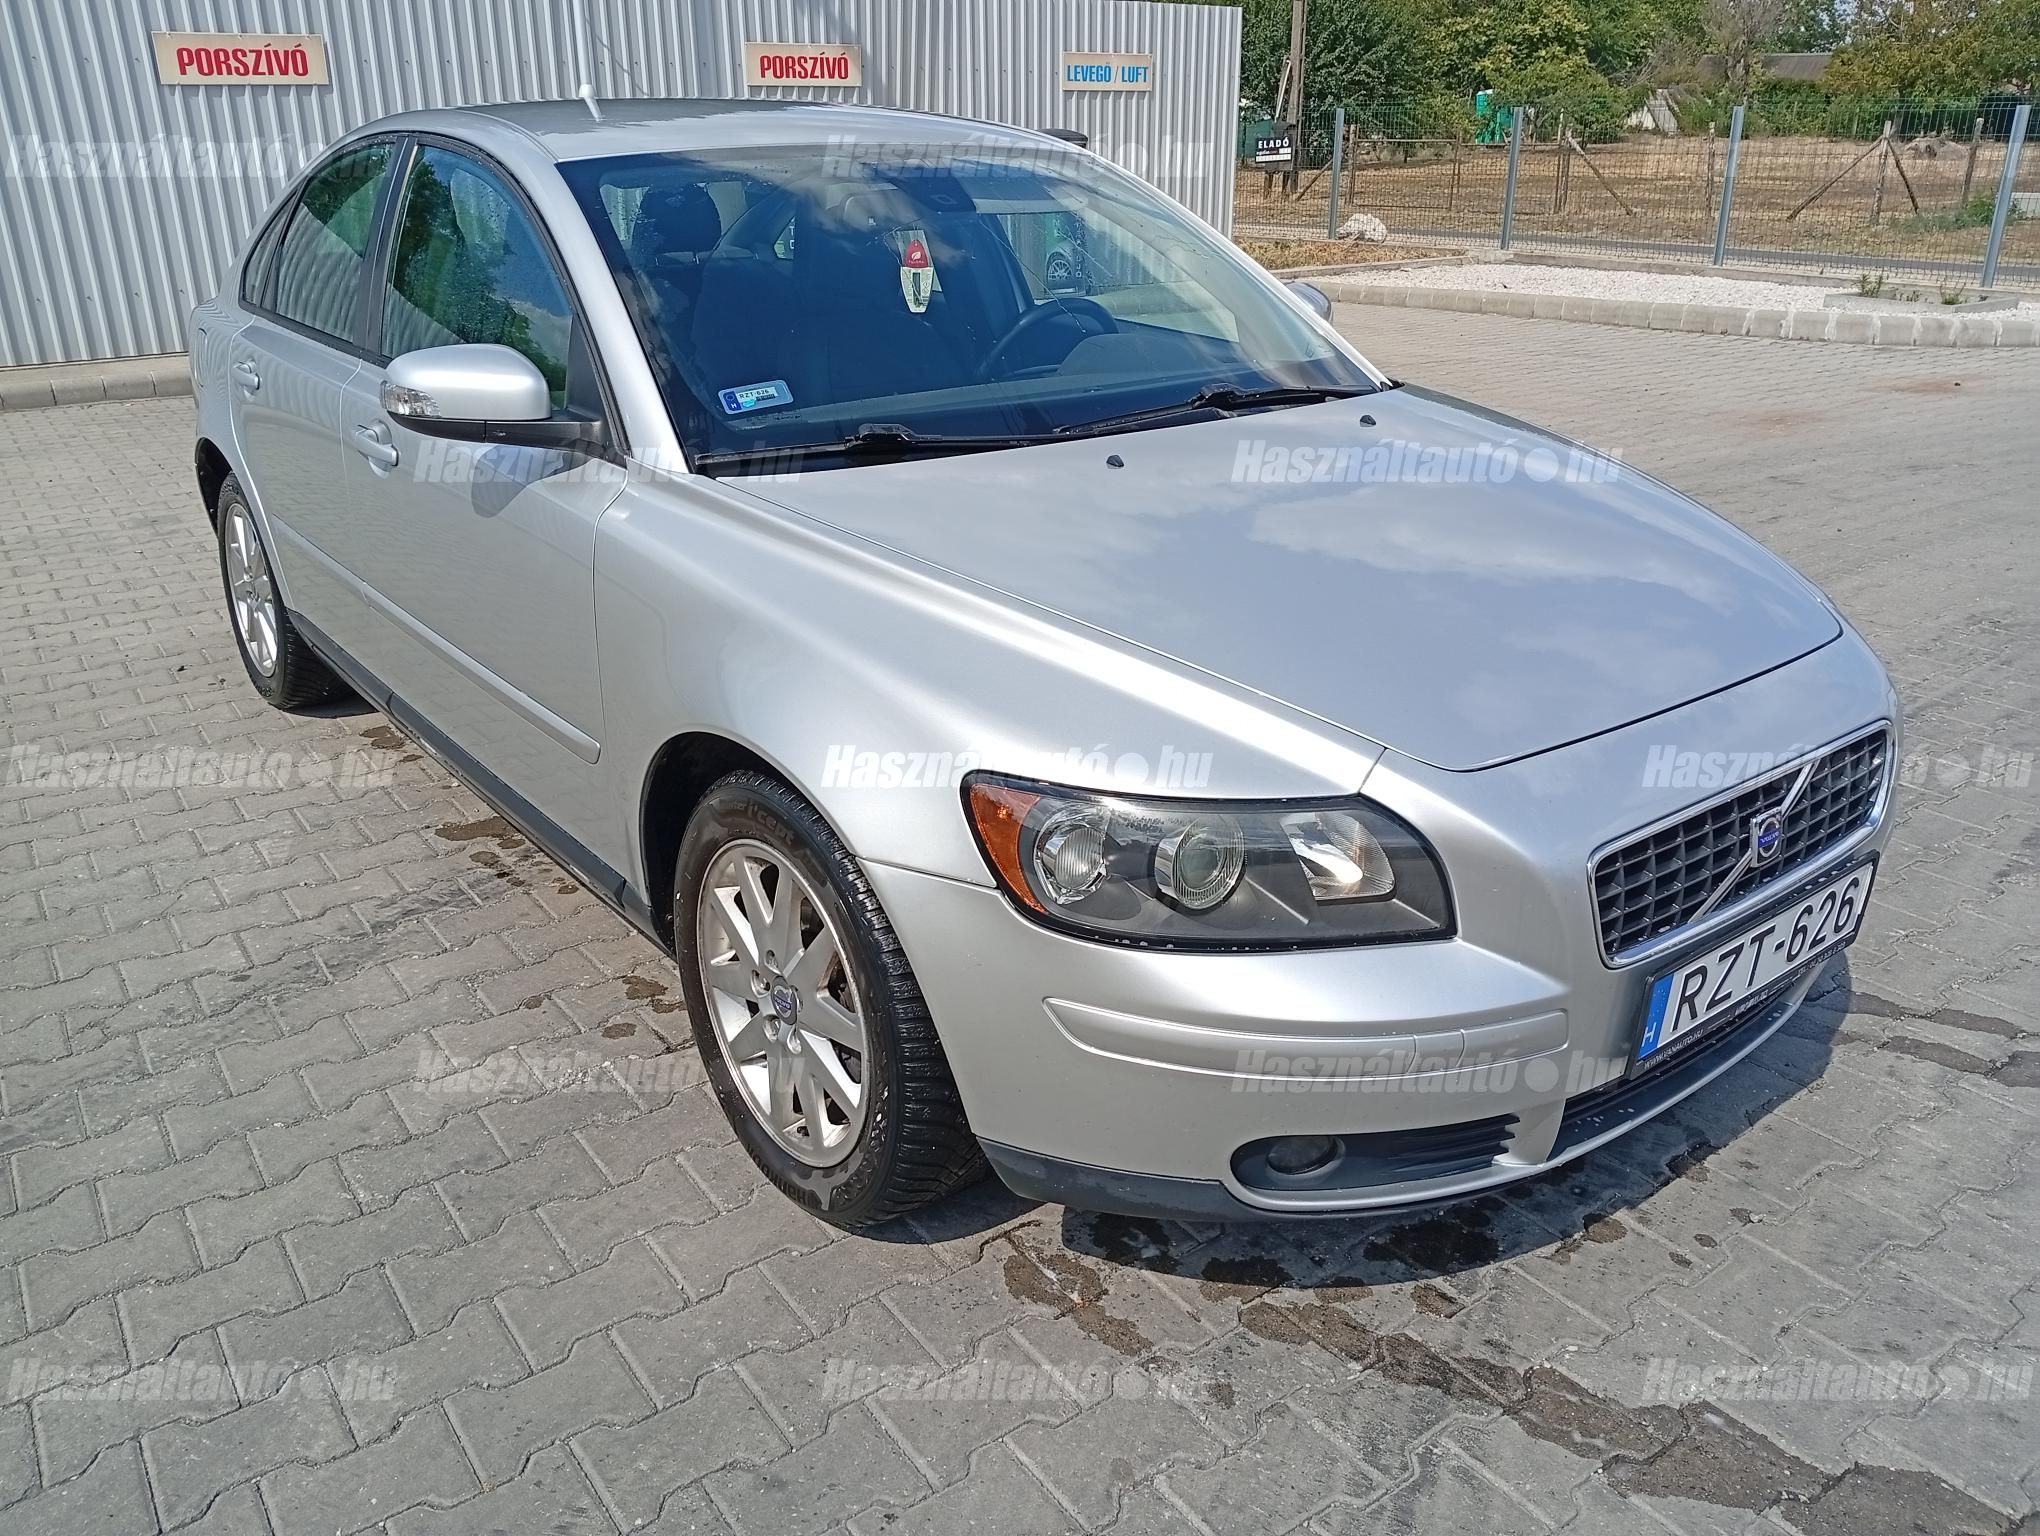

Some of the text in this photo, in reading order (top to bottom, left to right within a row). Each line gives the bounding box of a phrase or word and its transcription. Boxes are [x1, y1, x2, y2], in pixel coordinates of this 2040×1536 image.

[176, 43, 309, 77] PORSZÍVÓ
[759, 51, 849, 80] PORSZÍVÓ
[1121, 65, 1149, 83] LUFT
[1258, 136, 1289, 149] ELADÓ
[1671, 876, 1860, 1033] RZT-626
[1641, 1022, 1657, 1048] H
